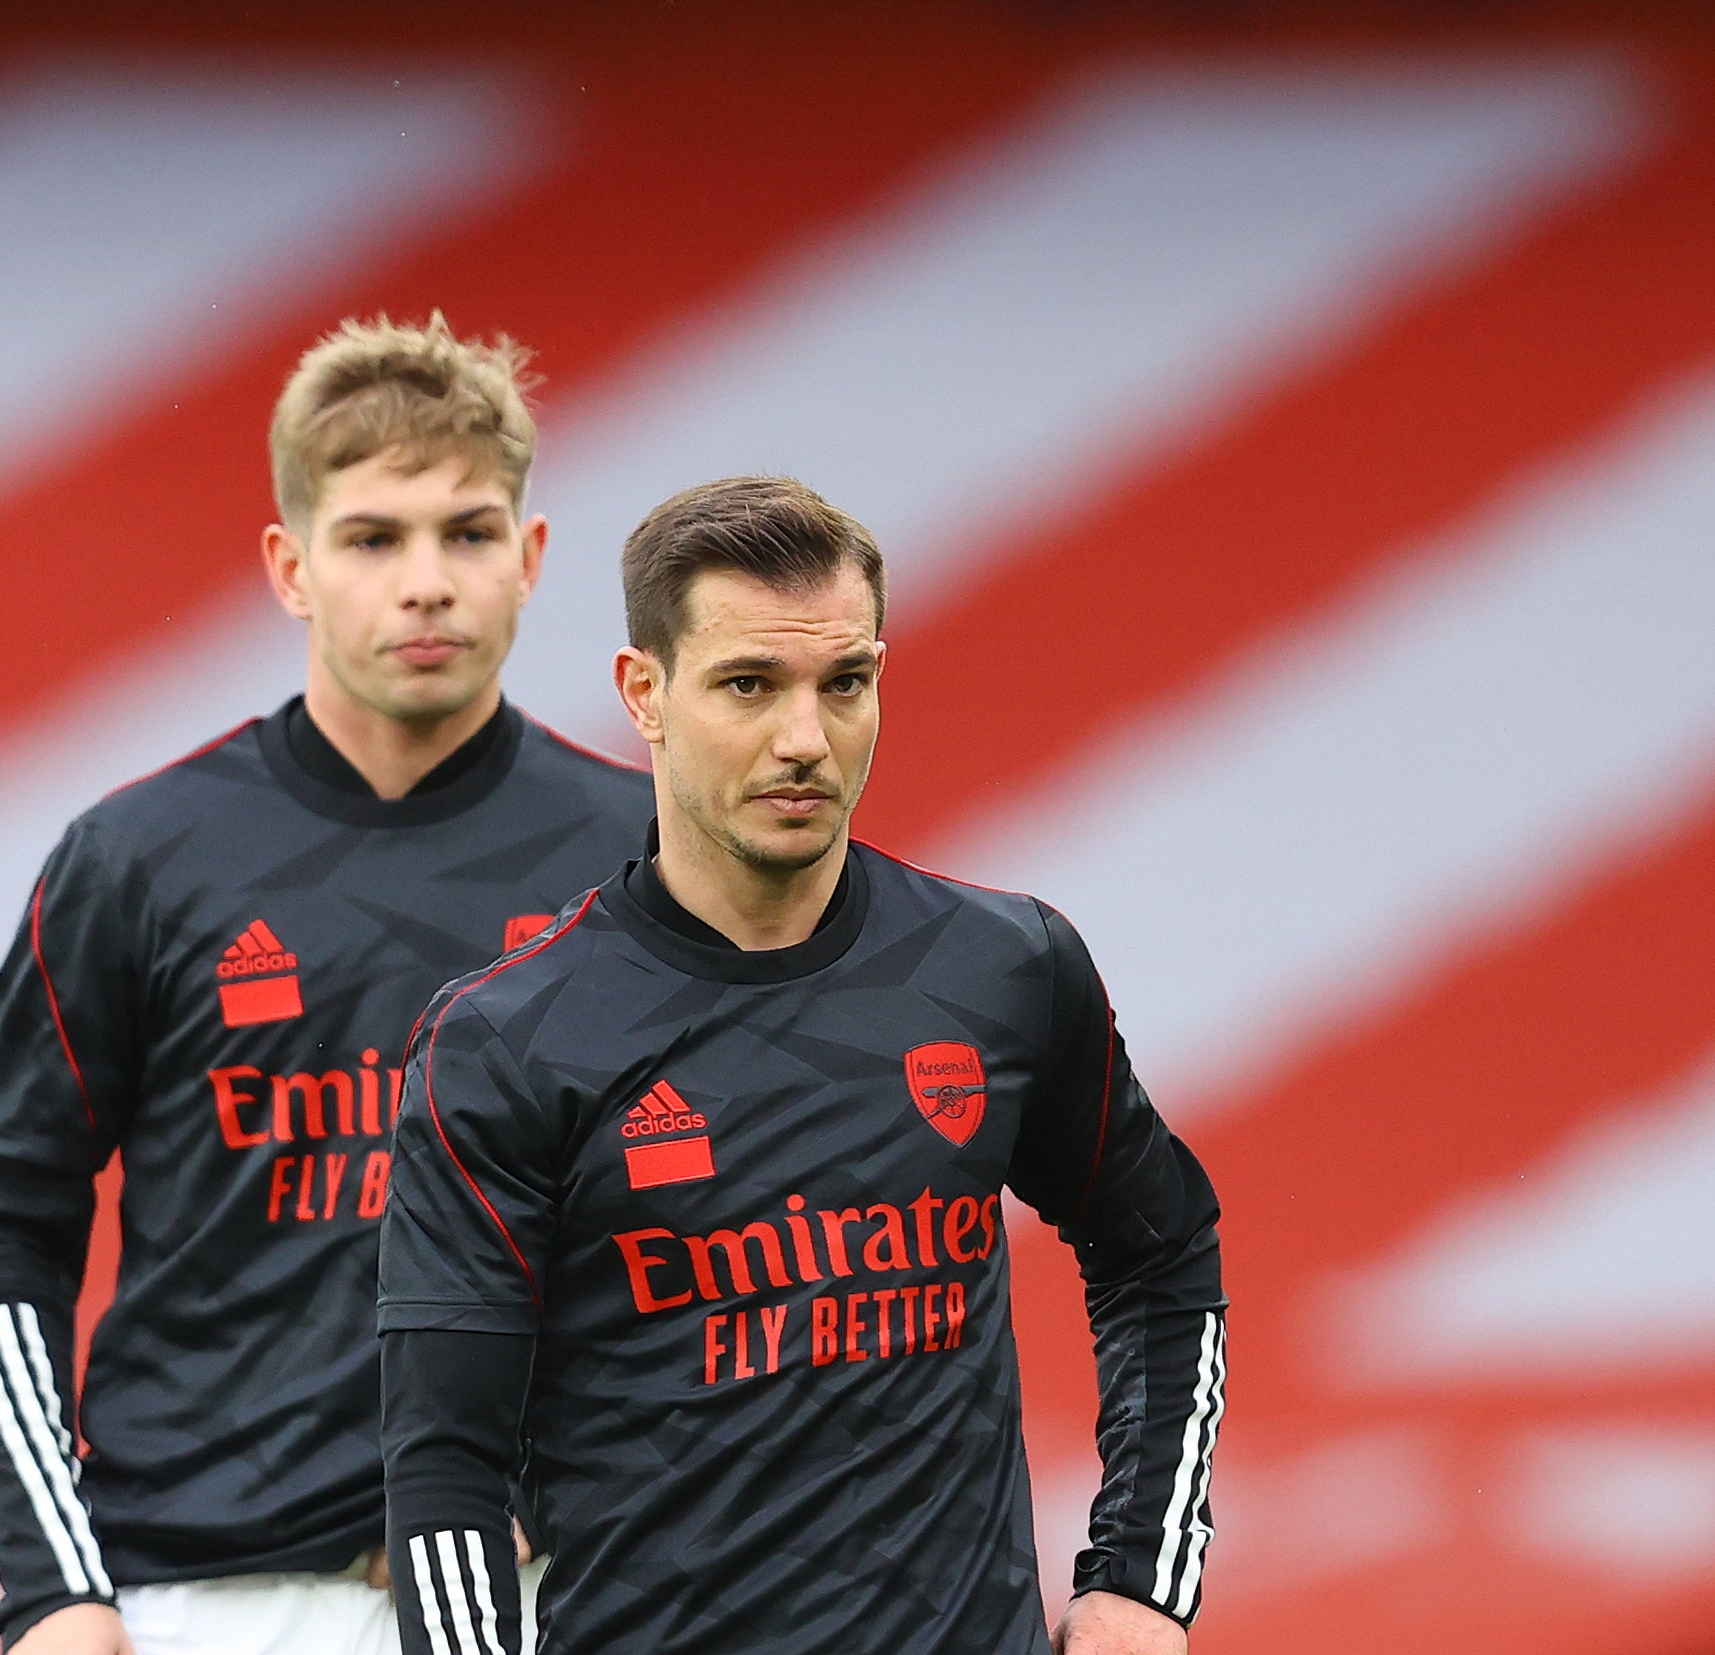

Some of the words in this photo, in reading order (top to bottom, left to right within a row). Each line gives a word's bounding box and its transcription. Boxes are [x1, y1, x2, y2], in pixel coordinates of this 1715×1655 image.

[216, 952, 299, 978] adidas
[916, 1059, 975, 1076] Arsenal
[620, 1111, 708, 1138] adidas
[268, 1153, 348, 1222] FLY
[612, 1186, 998, 1313] Emirates
[704, 1304, 787, 1385] FLY
[812, 1282, 966, 1367] BETTER
